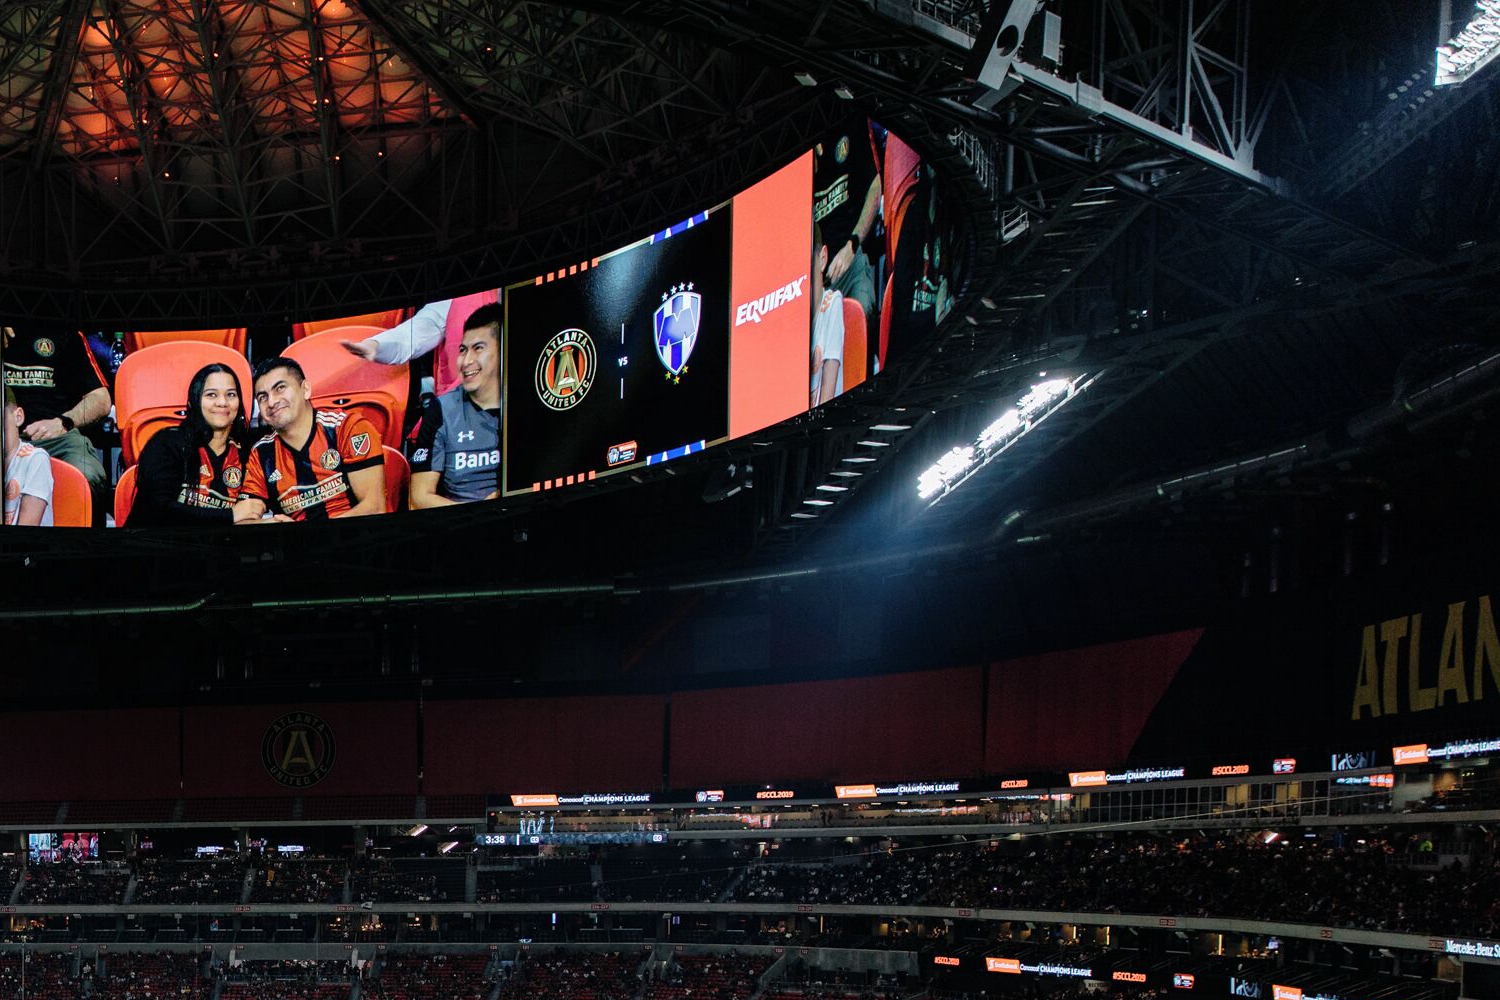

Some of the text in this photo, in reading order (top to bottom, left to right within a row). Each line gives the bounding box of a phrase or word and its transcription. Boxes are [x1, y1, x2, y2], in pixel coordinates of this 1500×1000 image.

[735, 277, 804, 326] EQUIFAX
[545, 331, 588, 357] ATLANTA
[24, 370, 54, 379] FAMILY
[542, 380, 590, 408] UNITED FC
[454, 449, 501, 470] Bana
[280, 477, 343, 507] AMERICAN FAMILY
[286, 488, 341, 513] INSURANCE
[1447, 743, 1479, 755] CHAMPIONS
[1479, 740, 1500, 749] LEAGUE
[1127, 770, 1161, 780] CHAMPIONS
[1161, 769, 1185, 777] LEAGUE
[1212, 764, 1250, 776] #SCCL2019
[899, 785, 934, 793] CHAMPIONS
[935, 783, 959, 791] LEAGUE
[1001, 779, 1028, 789] #SCCL2019
[584, 795, 623, 803] CHAMPIONS
[756, 790, 794, 799] #SCCL2019
[485, 835, 506, 844] 3:38
[1445, 939, 1494, 957] Mercedes-Benz
[934, 956, 960, 966] #SCCL2019
[1040, 964, 1071, 976] CHAMPIONS
[1071, 966, 1092, 977] LEAGUE
[1112, 971, 1146, 983] #SCCL2019
